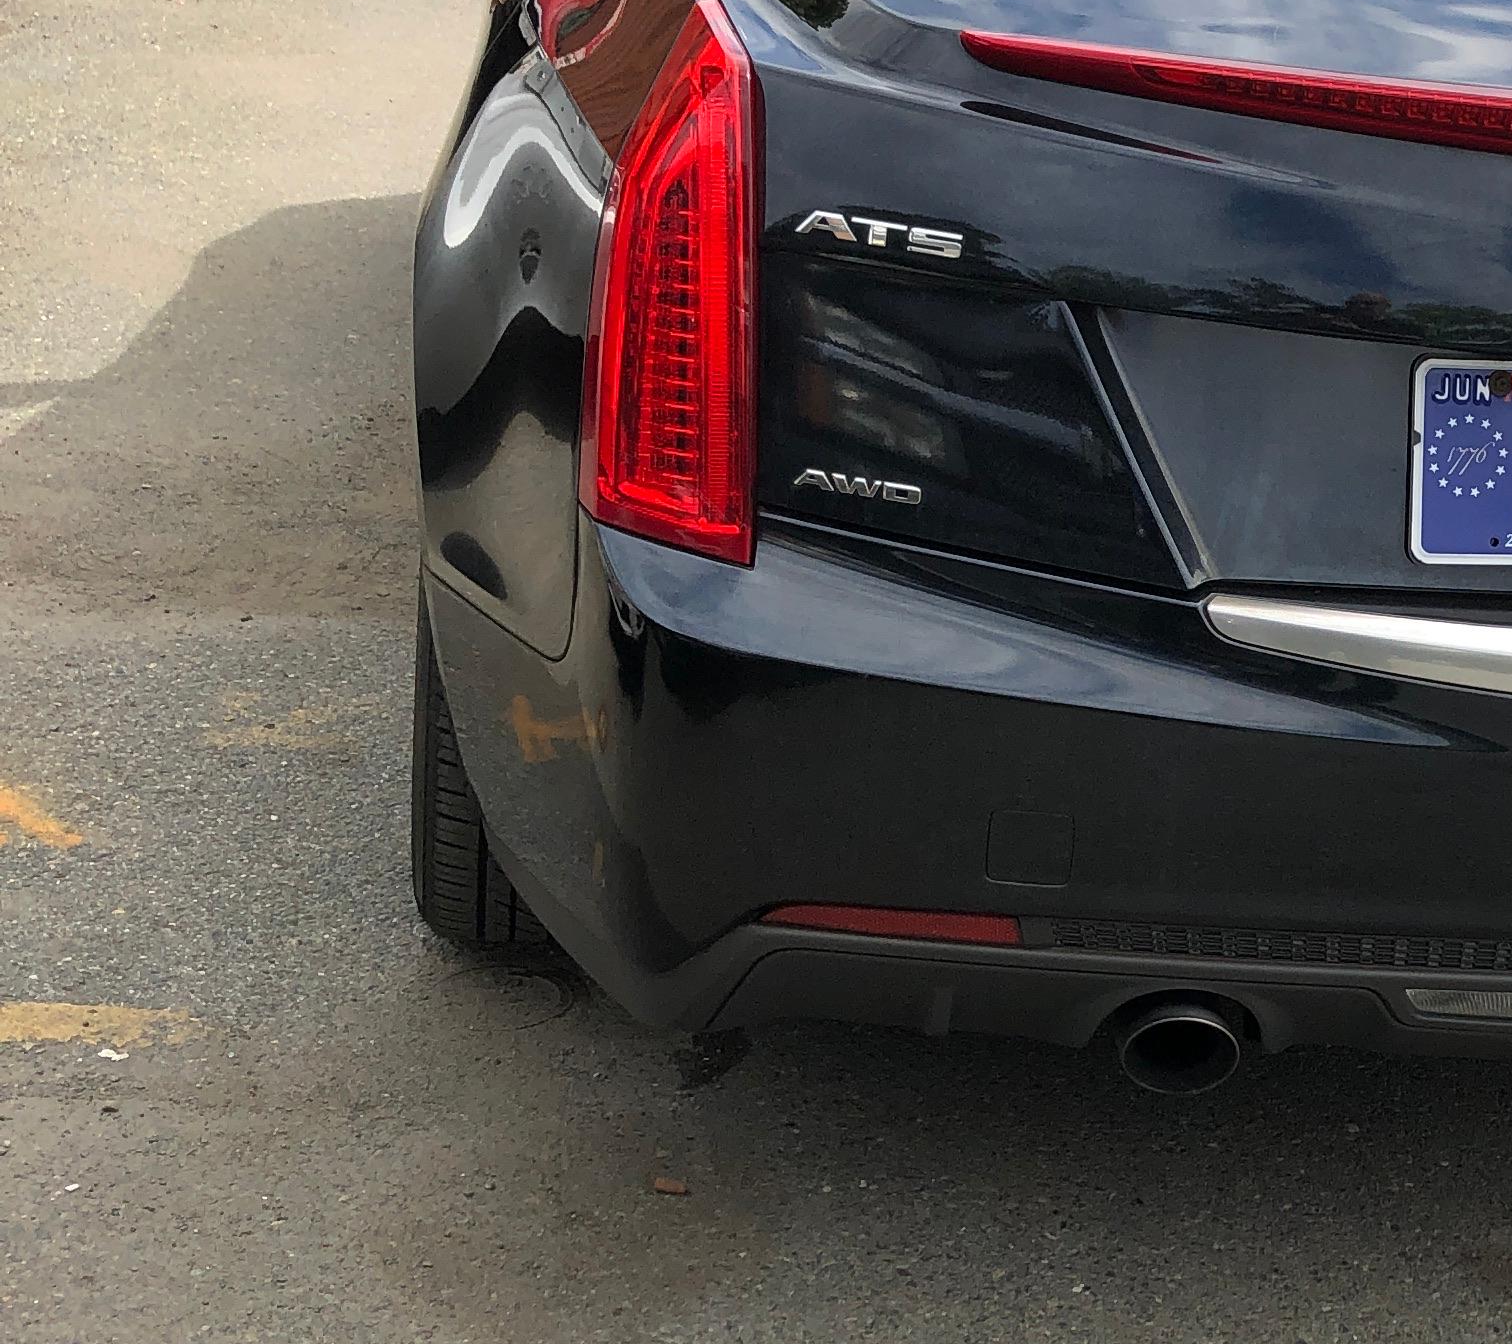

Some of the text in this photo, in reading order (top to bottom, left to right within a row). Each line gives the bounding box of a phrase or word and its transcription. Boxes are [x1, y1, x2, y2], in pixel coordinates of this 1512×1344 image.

[795, 210, 963, 258] ATS
[1433, 375, 1491, 403] JUN
[1446, 441, 1496, 476] 1776
[794, 468, 922, 505] AWD
